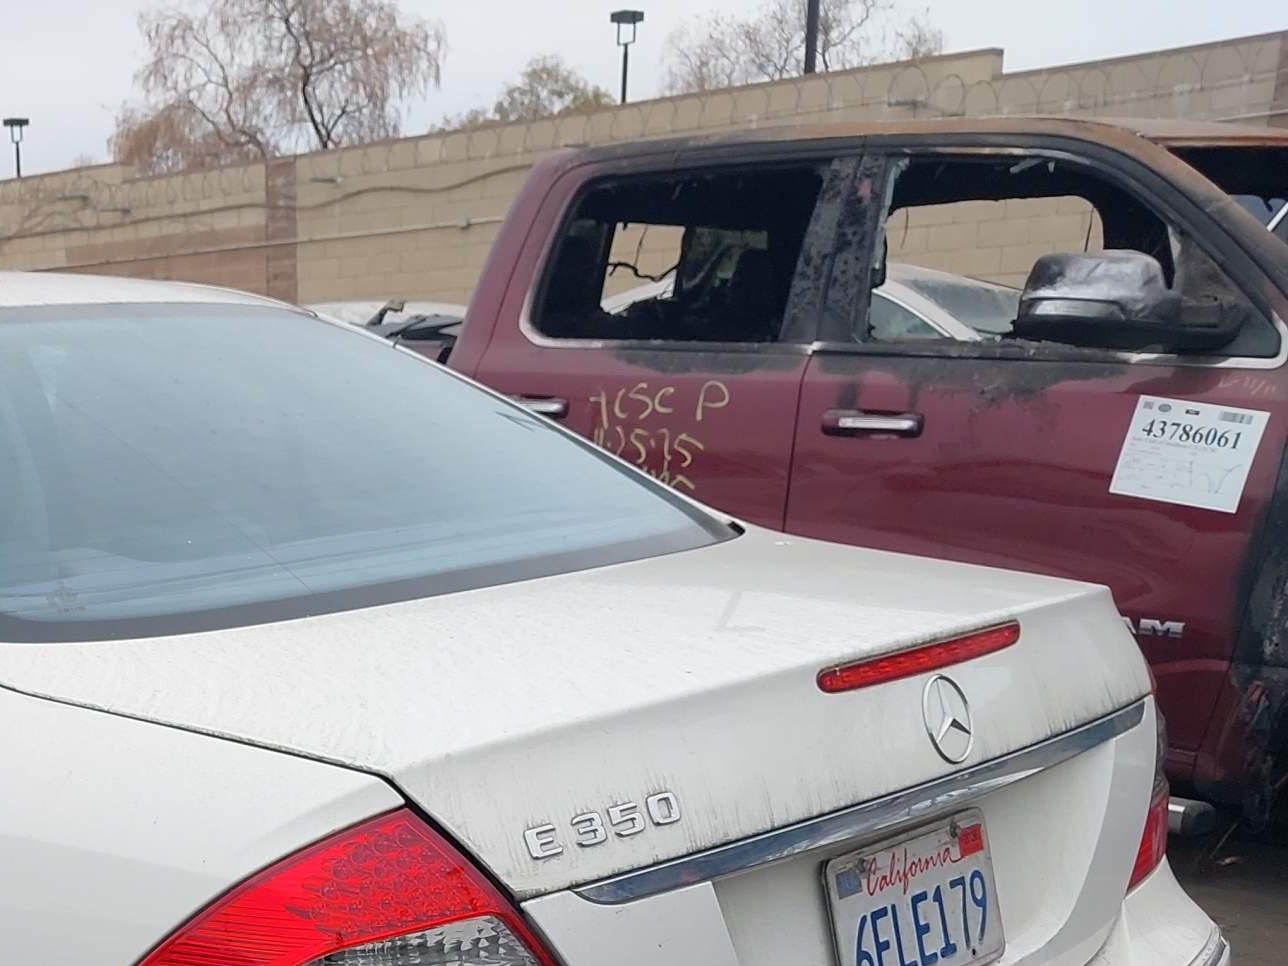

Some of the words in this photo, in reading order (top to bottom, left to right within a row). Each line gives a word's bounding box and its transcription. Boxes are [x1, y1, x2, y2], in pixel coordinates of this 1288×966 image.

[696, 380, 729, 421] P
[1141, 418, 1243, 450] 43786061
[523, 823, 564, 860] E
[570, 791, 682, 848] 350
[866, 847, 963, 896] California
